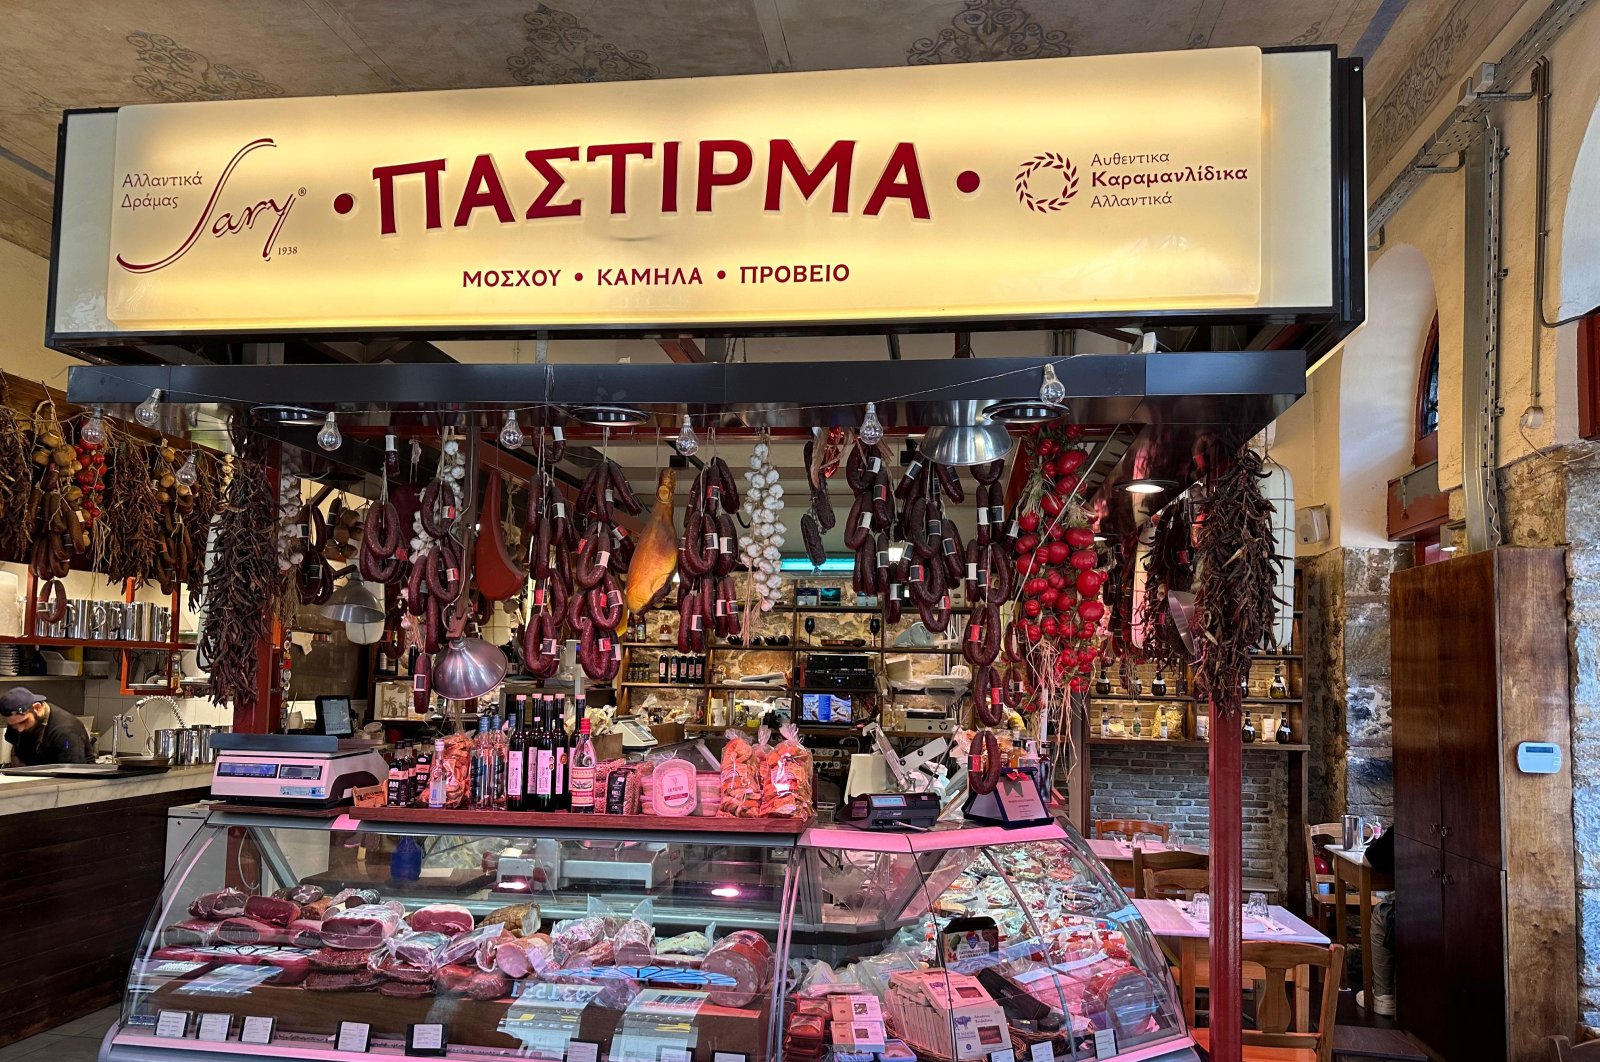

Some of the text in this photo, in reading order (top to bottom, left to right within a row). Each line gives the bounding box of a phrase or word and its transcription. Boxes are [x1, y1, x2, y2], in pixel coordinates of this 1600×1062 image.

[1090, 152, 1170, 167] Αυθεντικα
[121, 171, 203, 188] Αλλαντικά
[1090, 165, 1248, 190] Καραμανλίδικα
[372, 138, 930, 235] ΠΑΣΤΙΡΜΑ
[121, 193, 178, 211] Δράμας
[1090, 191, 1173, 208] Αλλαντικά
[278, 246, 298, 256] 1938
[463, 264, 850, 287] ΜΟΣΧΟΥ ΚΑΜΗΛΑ ΠΡΟΒΕΙΟ
